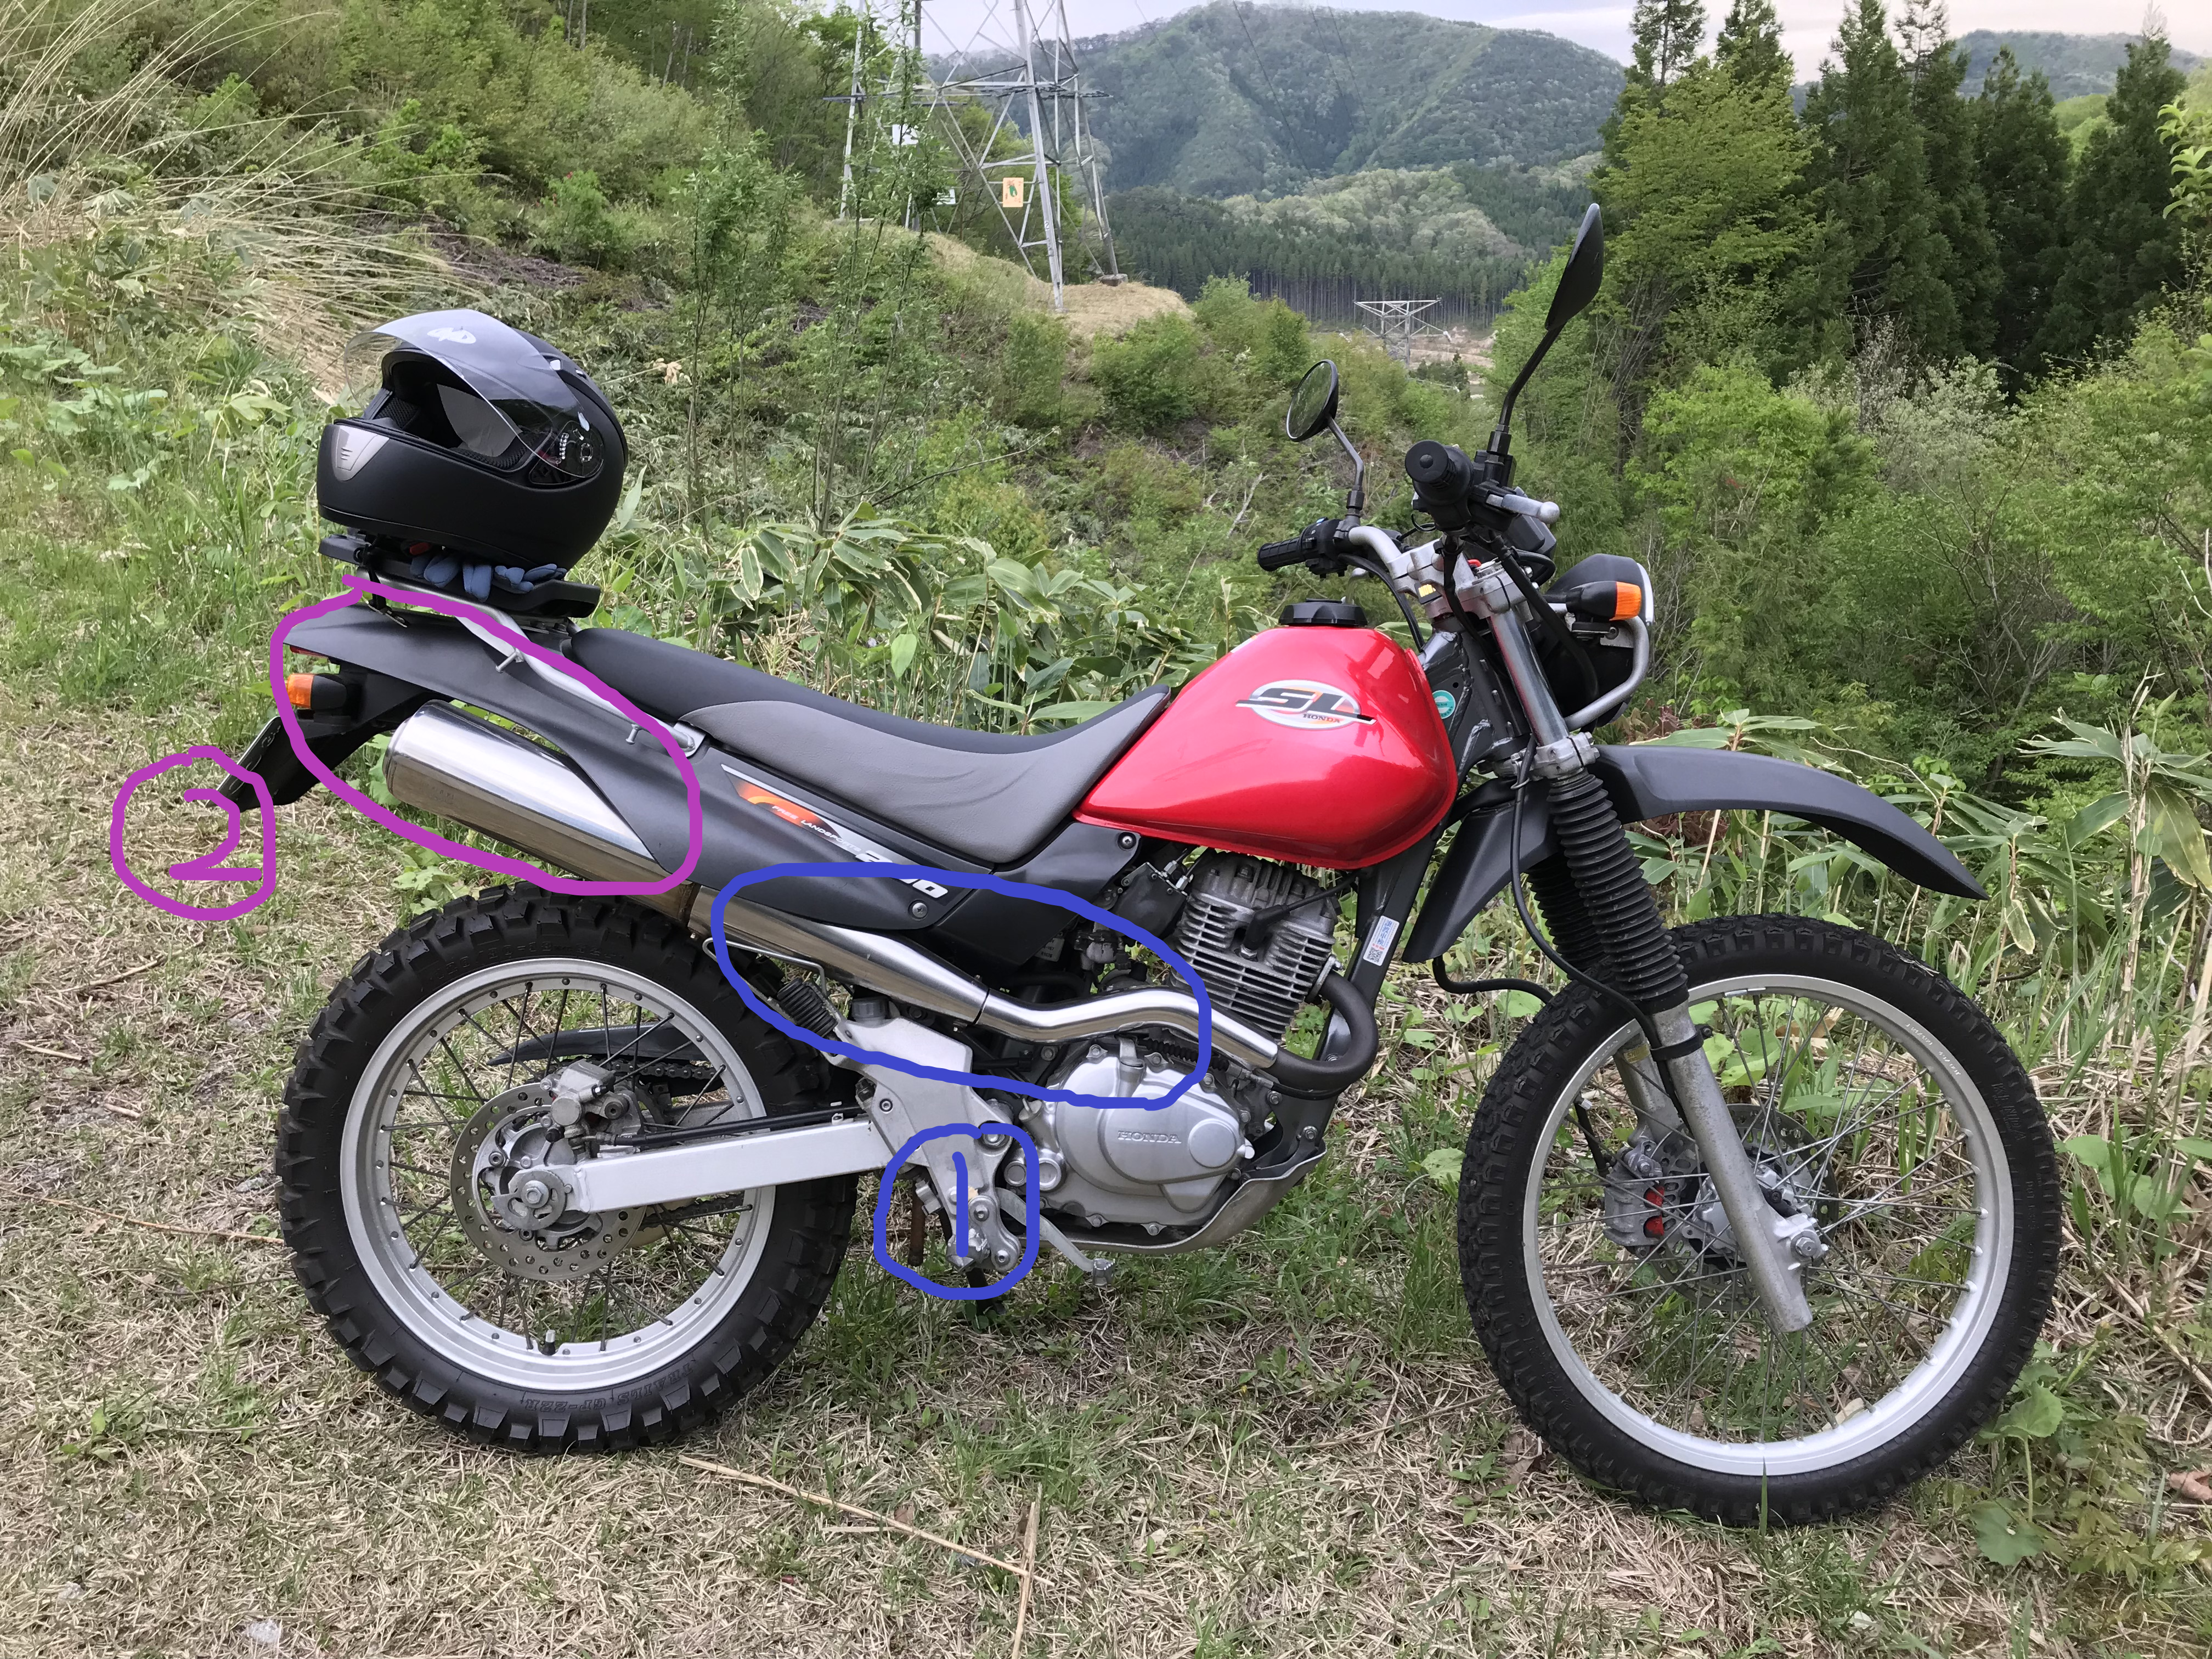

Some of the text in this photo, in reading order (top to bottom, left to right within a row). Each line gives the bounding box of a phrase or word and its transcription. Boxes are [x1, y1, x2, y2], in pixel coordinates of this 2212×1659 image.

[1235, 688, 1376, 723] SL
[1303, 713, 1340, 724] HONDA
[772, 805, 799, 820] FREE
[855, 850, 949, 899] 20
[1117, 1130, 1182, 1149] HONDA
[526, 1363, 694, 1413] TRAILS GP-22R
